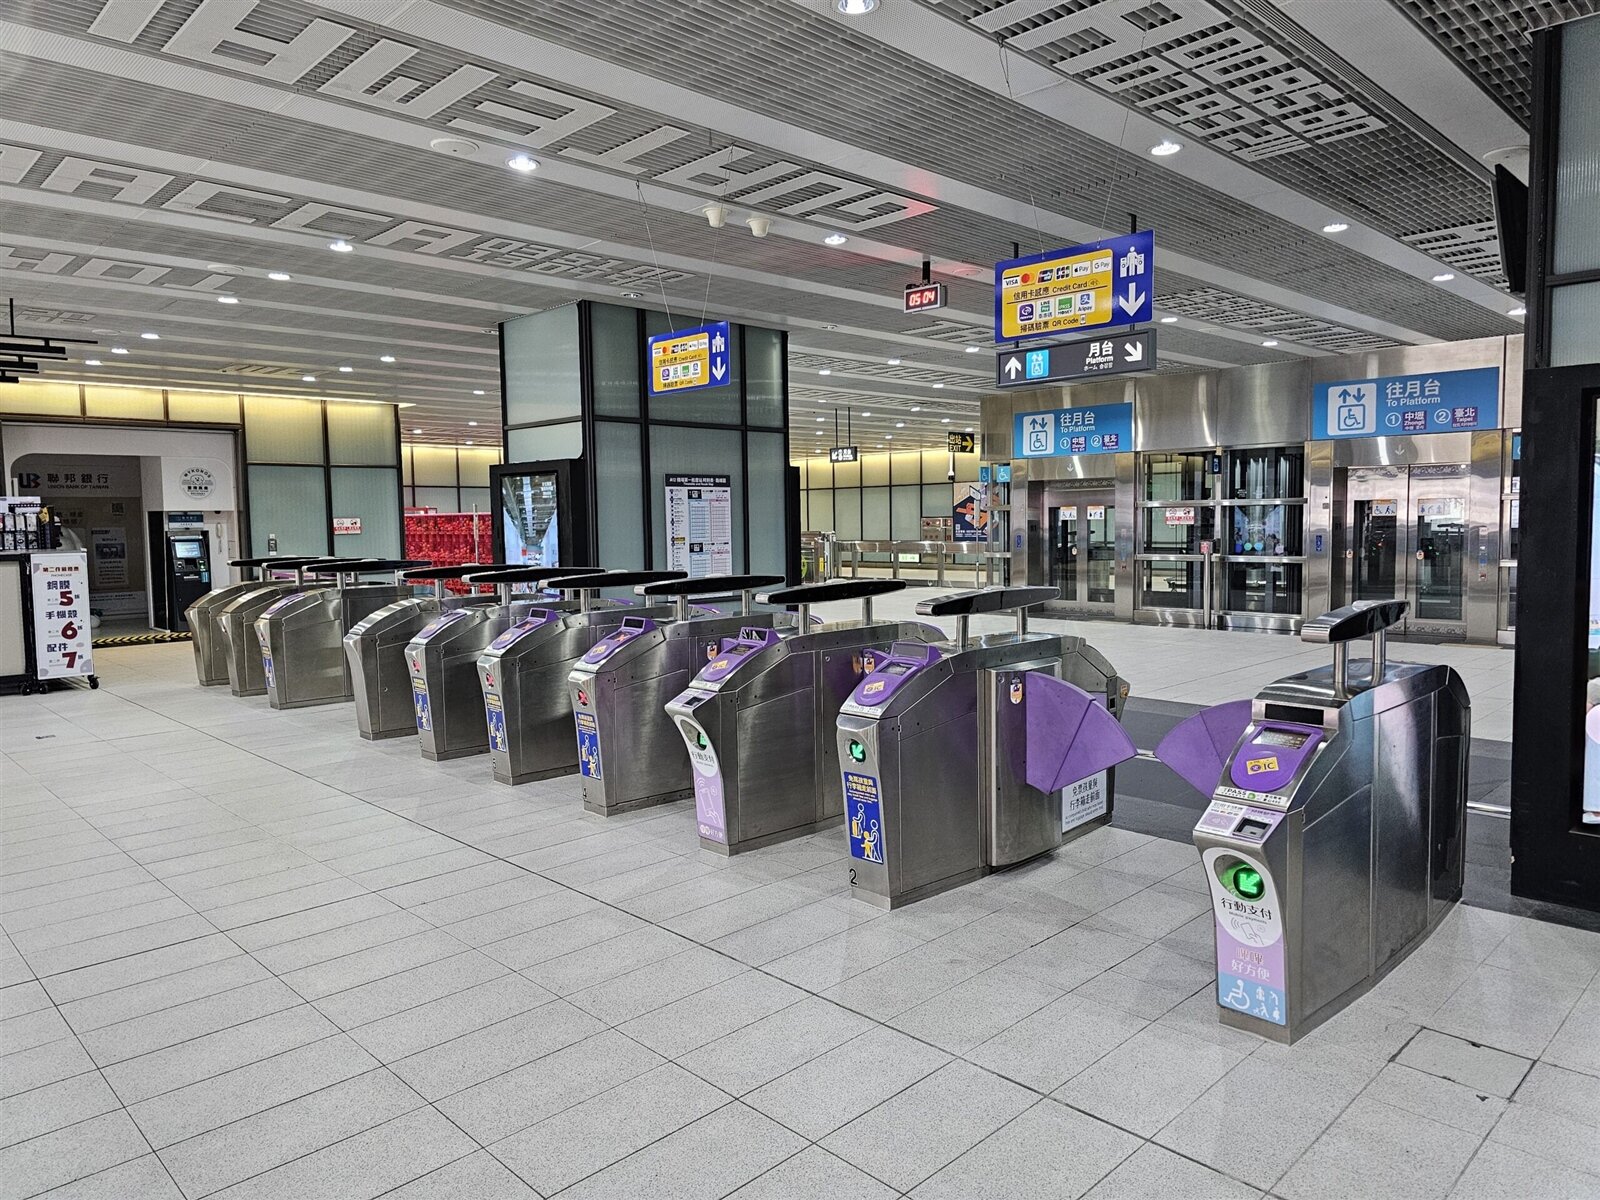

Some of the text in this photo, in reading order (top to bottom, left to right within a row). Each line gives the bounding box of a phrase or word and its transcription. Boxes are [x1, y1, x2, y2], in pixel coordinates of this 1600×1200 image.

[1014, 281, 1087, 300] 信用卡感應 Credit Card
[1020, 317, 1079, 333] 掃碼驗票 QR Code
[1088, 341, 1113, 357] 月台
[1085, 356, 1114, 364] Platform
[1385, 378, 1441, 399] 往月台
[1386, 396, 1441, 407] To Platform
[1060, 411, 1095, 427] 往月台
[1404, 411, 1425, 421] 中壢
[1454, 407, 1475, 418] 臺北
[1069, 425, 1095, 433] Platform
[949, 444, 962, 452] EXIT
[47, 472, 109, 484] 聯邦銀行
[60, 591, 73, 606] 5
[45, 610, 77, 620] 手機殼
[61, 621, 77, 639] 6
[47, 643, 68, 653] 配件
[62, 651, 77, 669] 7
[1263, 762, 1275, 770] IC
[849, 868, 858, 886] 2
[1221, 897, 1272, 921] 行動支付
[1231, 959, 1270, 981] 好方便
